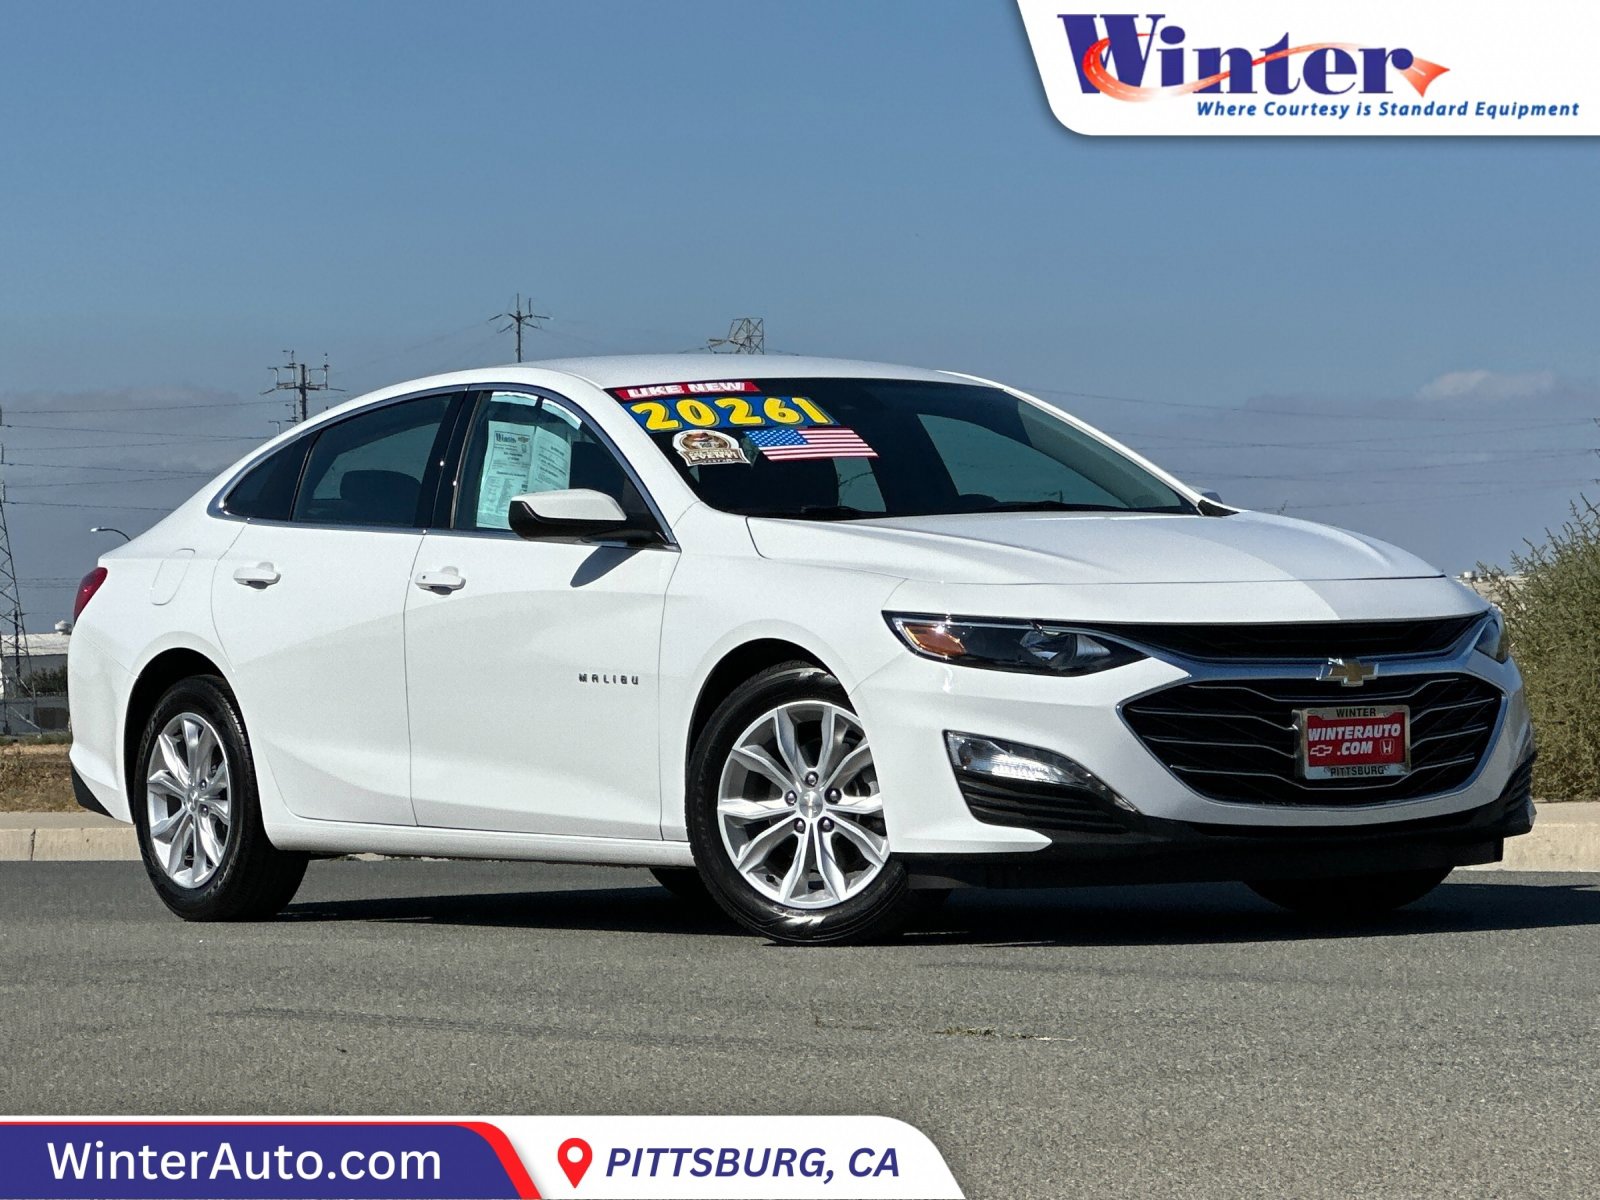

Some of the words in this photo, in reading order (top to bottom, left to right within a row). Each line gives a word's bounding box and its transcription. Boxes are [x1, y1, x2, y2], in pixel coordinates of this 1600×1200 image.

[627, 384, 685, 398] LIKE
[689, 381, 745, 394] NEW
[630, 396, 833, 431] 20261
[578, 673, 639, 686] MALIBU
[1336, 707, 1377, 718] WINTER
[1308, 723, 1401, 741] WINTERAUTO
[1336, 740, 1373, 756] .COM
[1330, 765, 1385, 777] PITTSBURG
